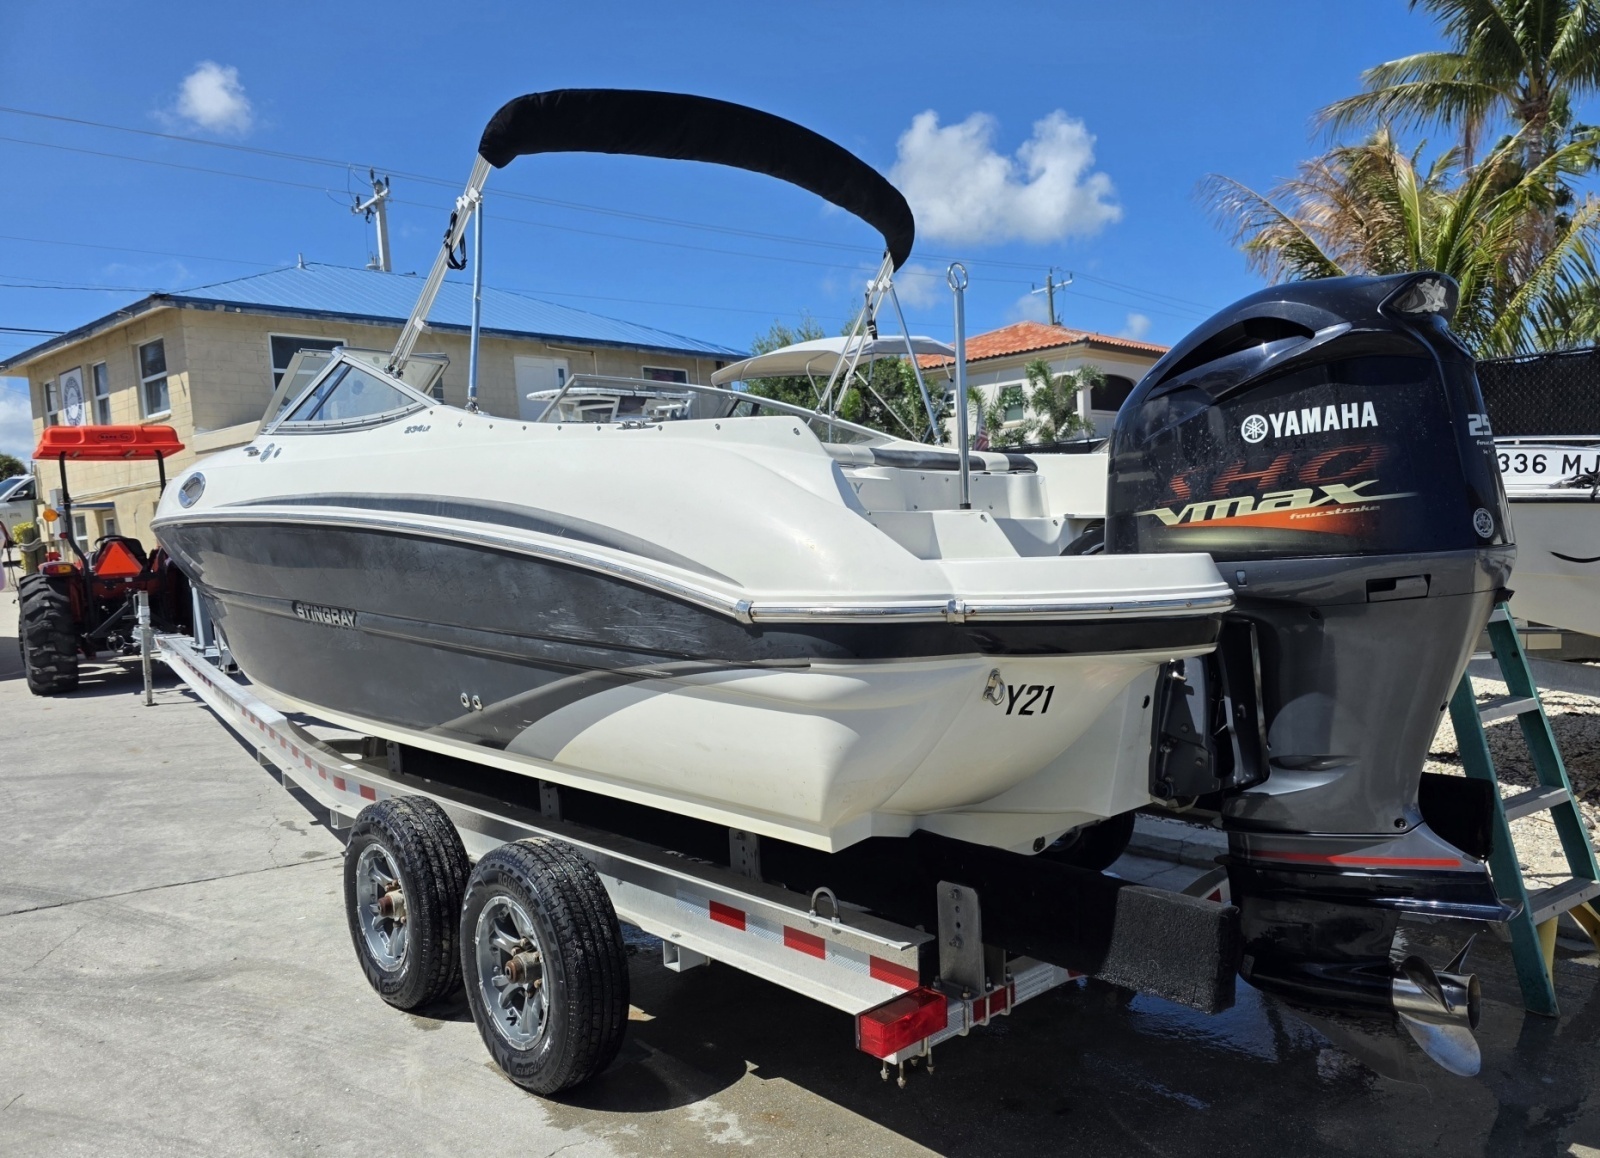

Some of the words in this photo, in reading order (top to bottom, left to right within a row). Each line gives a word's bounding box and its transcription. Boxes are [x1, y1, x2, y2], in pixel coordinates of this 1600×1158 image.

[1268, 401, 1379, 438] YAMAHA
[1497, 453, 1548, 474] 336
[1289, 504, 1381, 520] fourstroke
[293, 601, 356, 628] STINGRAY
[1005, 683, 1055, 716] Y21
